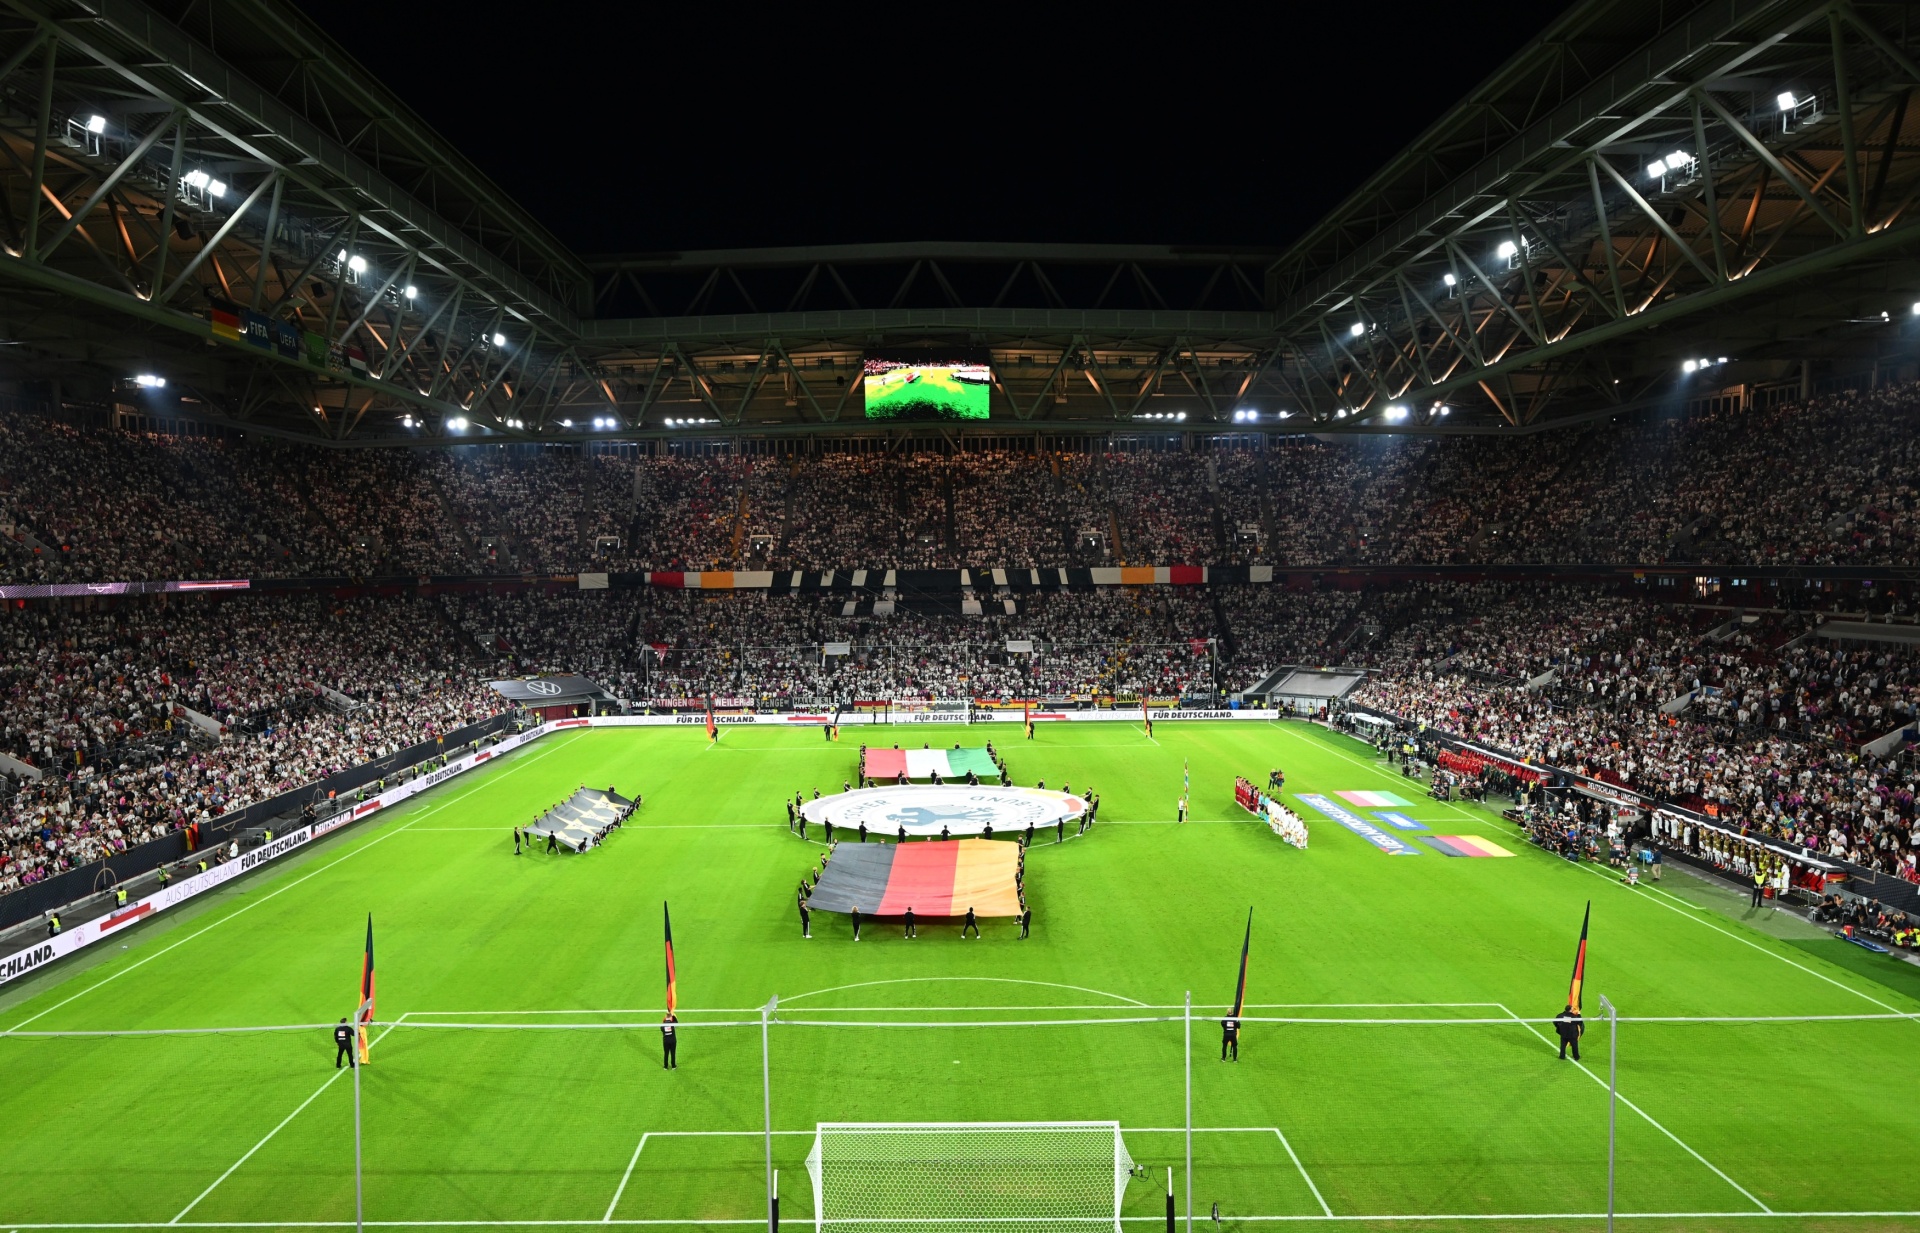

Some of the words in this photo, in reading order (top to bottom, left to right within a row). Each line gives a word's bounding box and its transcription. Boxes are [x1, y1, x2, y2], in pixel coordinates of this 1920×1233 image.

[250, 321, 268, 339] FIFA
[279, 332, 296, 348] UEFA
[756, 698, 784, 708] SPENGE
[676, 715, 692, 723] FÜR
[914, 712, 930, 721] FÜR
[1153, 709, 1170, 718] FÜR
[425, 772, 434, 786] FÜR
[434, 763, 463, 783] DEUTSCHLAND.
[1587, 781, 1618, 797] DEUTSCHLAND
[1620, 793, 1641, 805] UNGARN
[314, 811, 351, 834] DEUTSCHLAND
[165, 888, 182, 906] AUS
[183, 861, 238, 897] DEUTSCHLAND
[241, 852, 256, 870] FÜR
[257, 831, 308, 862] DEUTSCHLAND.
